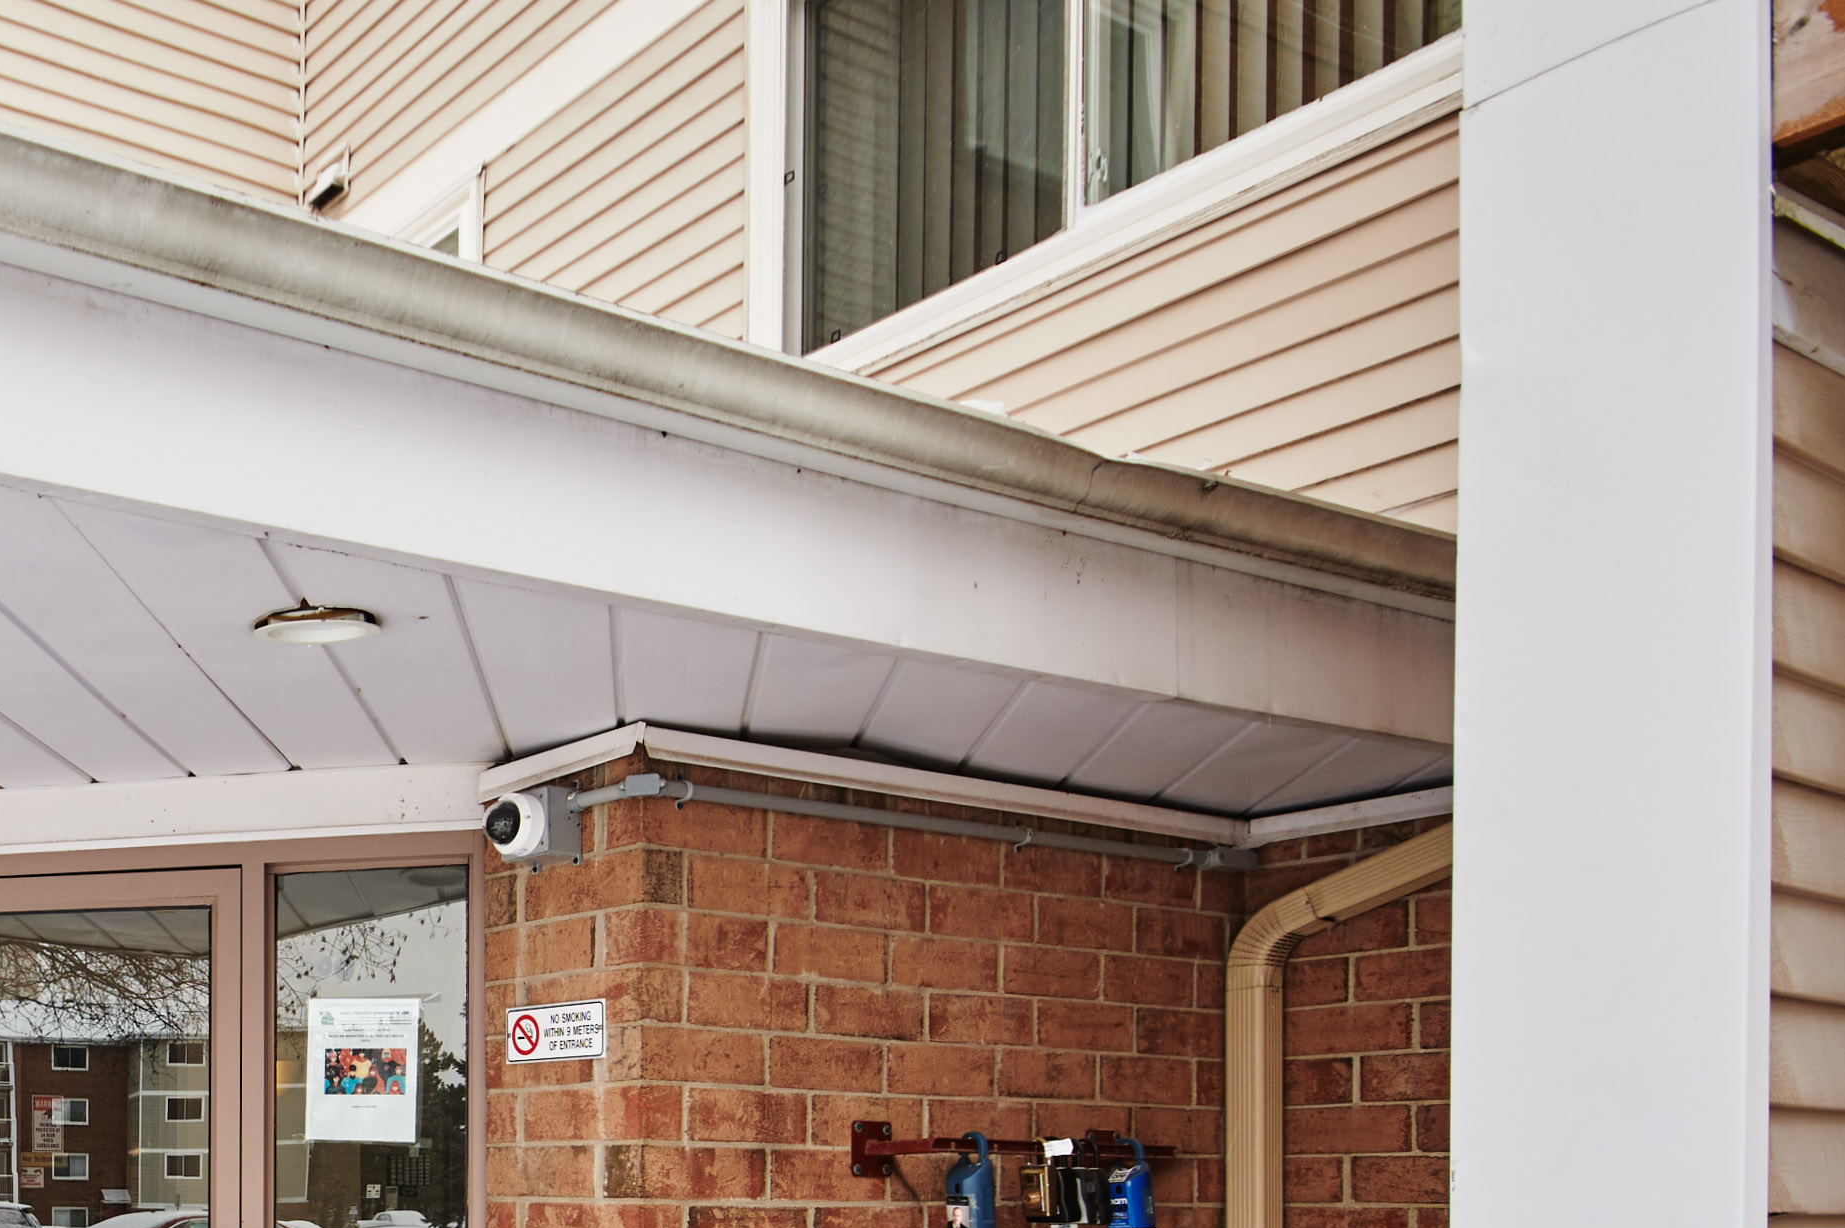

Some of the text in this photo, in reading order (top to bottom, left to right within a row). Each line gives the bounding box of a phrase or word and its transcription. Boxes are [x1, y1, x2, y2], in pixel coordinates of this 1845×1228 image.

[550, 1011, 591, 1023] NO SMOKING
[543, 1024, 598, 1038] WITHIN 9 METERS
[548, 1038, 593, 1051] OF ENTRANCE
[35, 1100, 62, 1108] WARNNG
